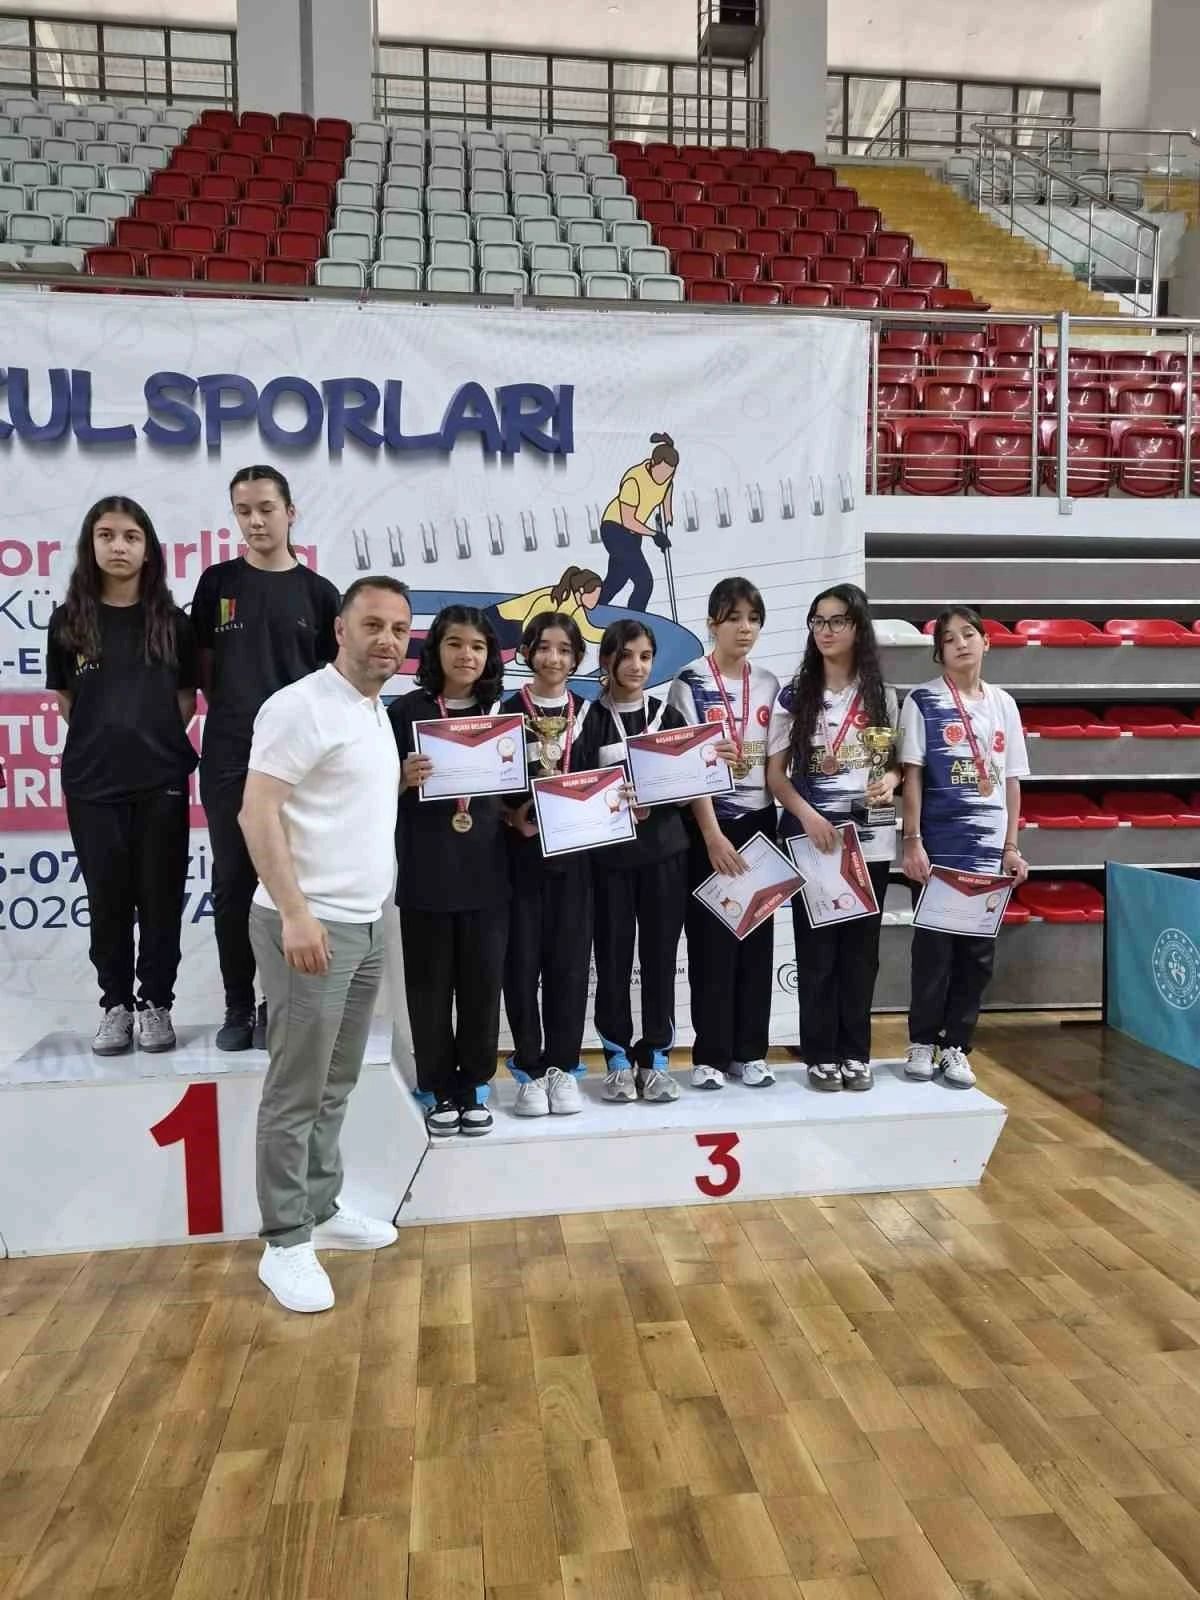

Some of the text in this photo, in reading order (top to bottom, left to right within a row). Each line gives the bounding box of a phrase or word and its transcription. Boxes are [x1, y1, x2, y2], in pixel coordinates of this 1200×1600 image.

[142, 371, 575, 454] SPORLARI
[149, 1082, 224, 1236] 1
[695, 1132, 741, 1197] 3
